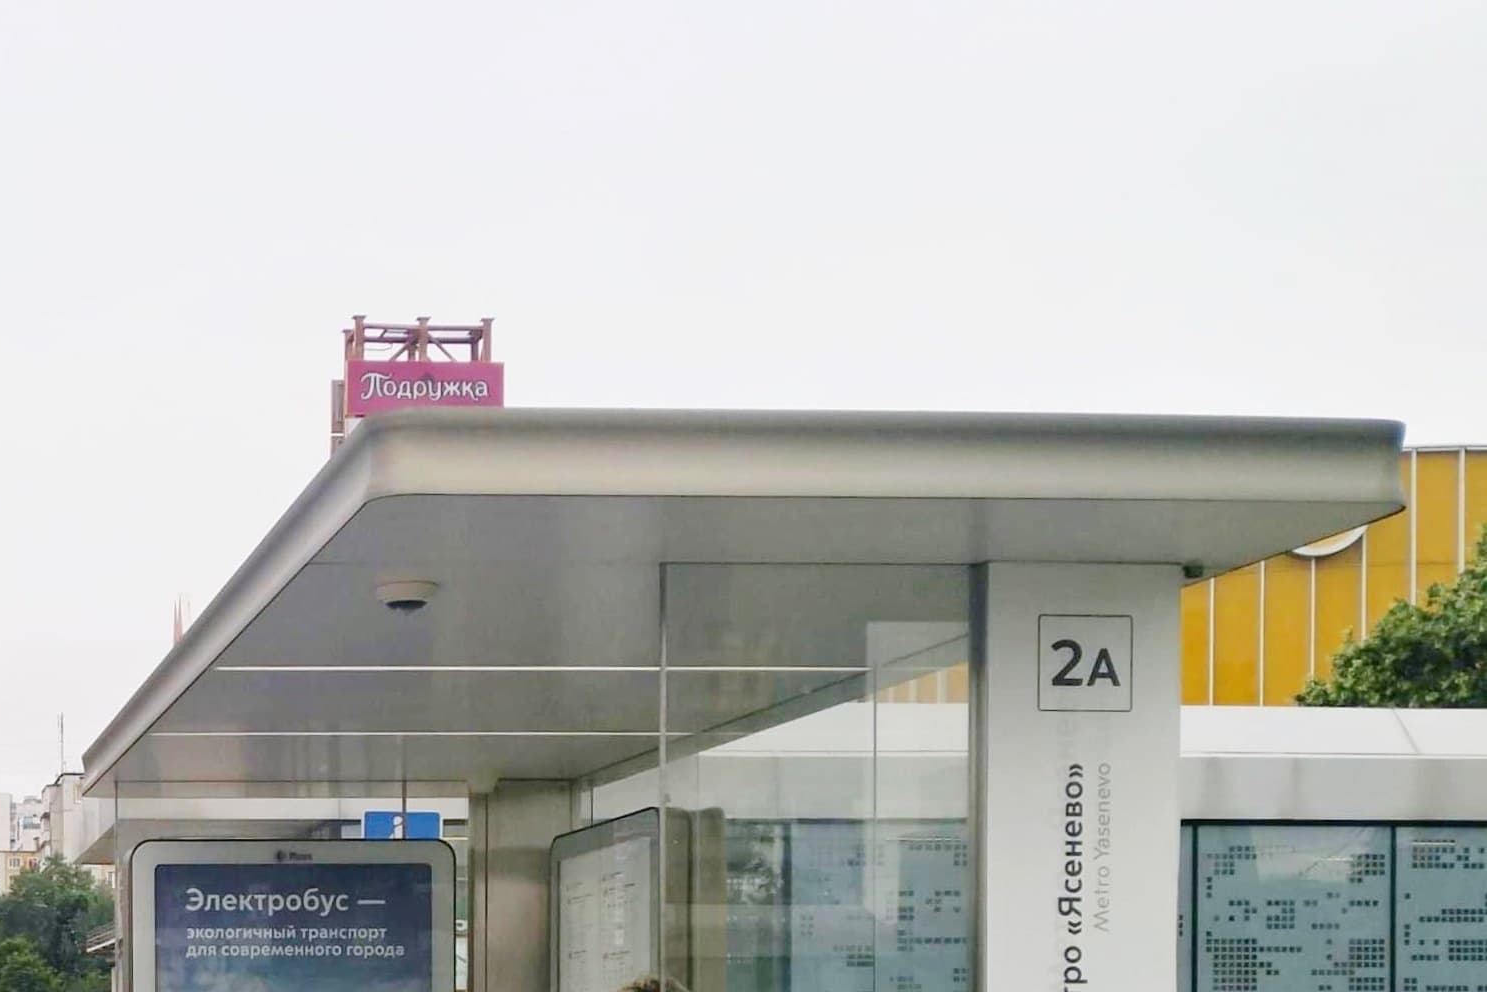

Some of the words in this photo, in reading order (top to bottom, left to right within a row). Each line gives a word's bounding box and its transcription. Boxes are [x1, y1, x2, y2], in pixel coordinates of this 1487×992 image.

[360, 372, 489, 402] Подружка
[1093, 761, 1112, 860] Yasenevo
[1057, 762, 1085, 936] «Ясенево»
[184, 887, 349, 917] Электробус
[1092, 864, 1111, 933] Metro
[185, 925, 297, 940] экологичный
[300, 926, 388, 942] транспорт
[185, 943, 216, 959] для
[220, 943, 342, 960] современного
[345, 943, 405, 959] города
